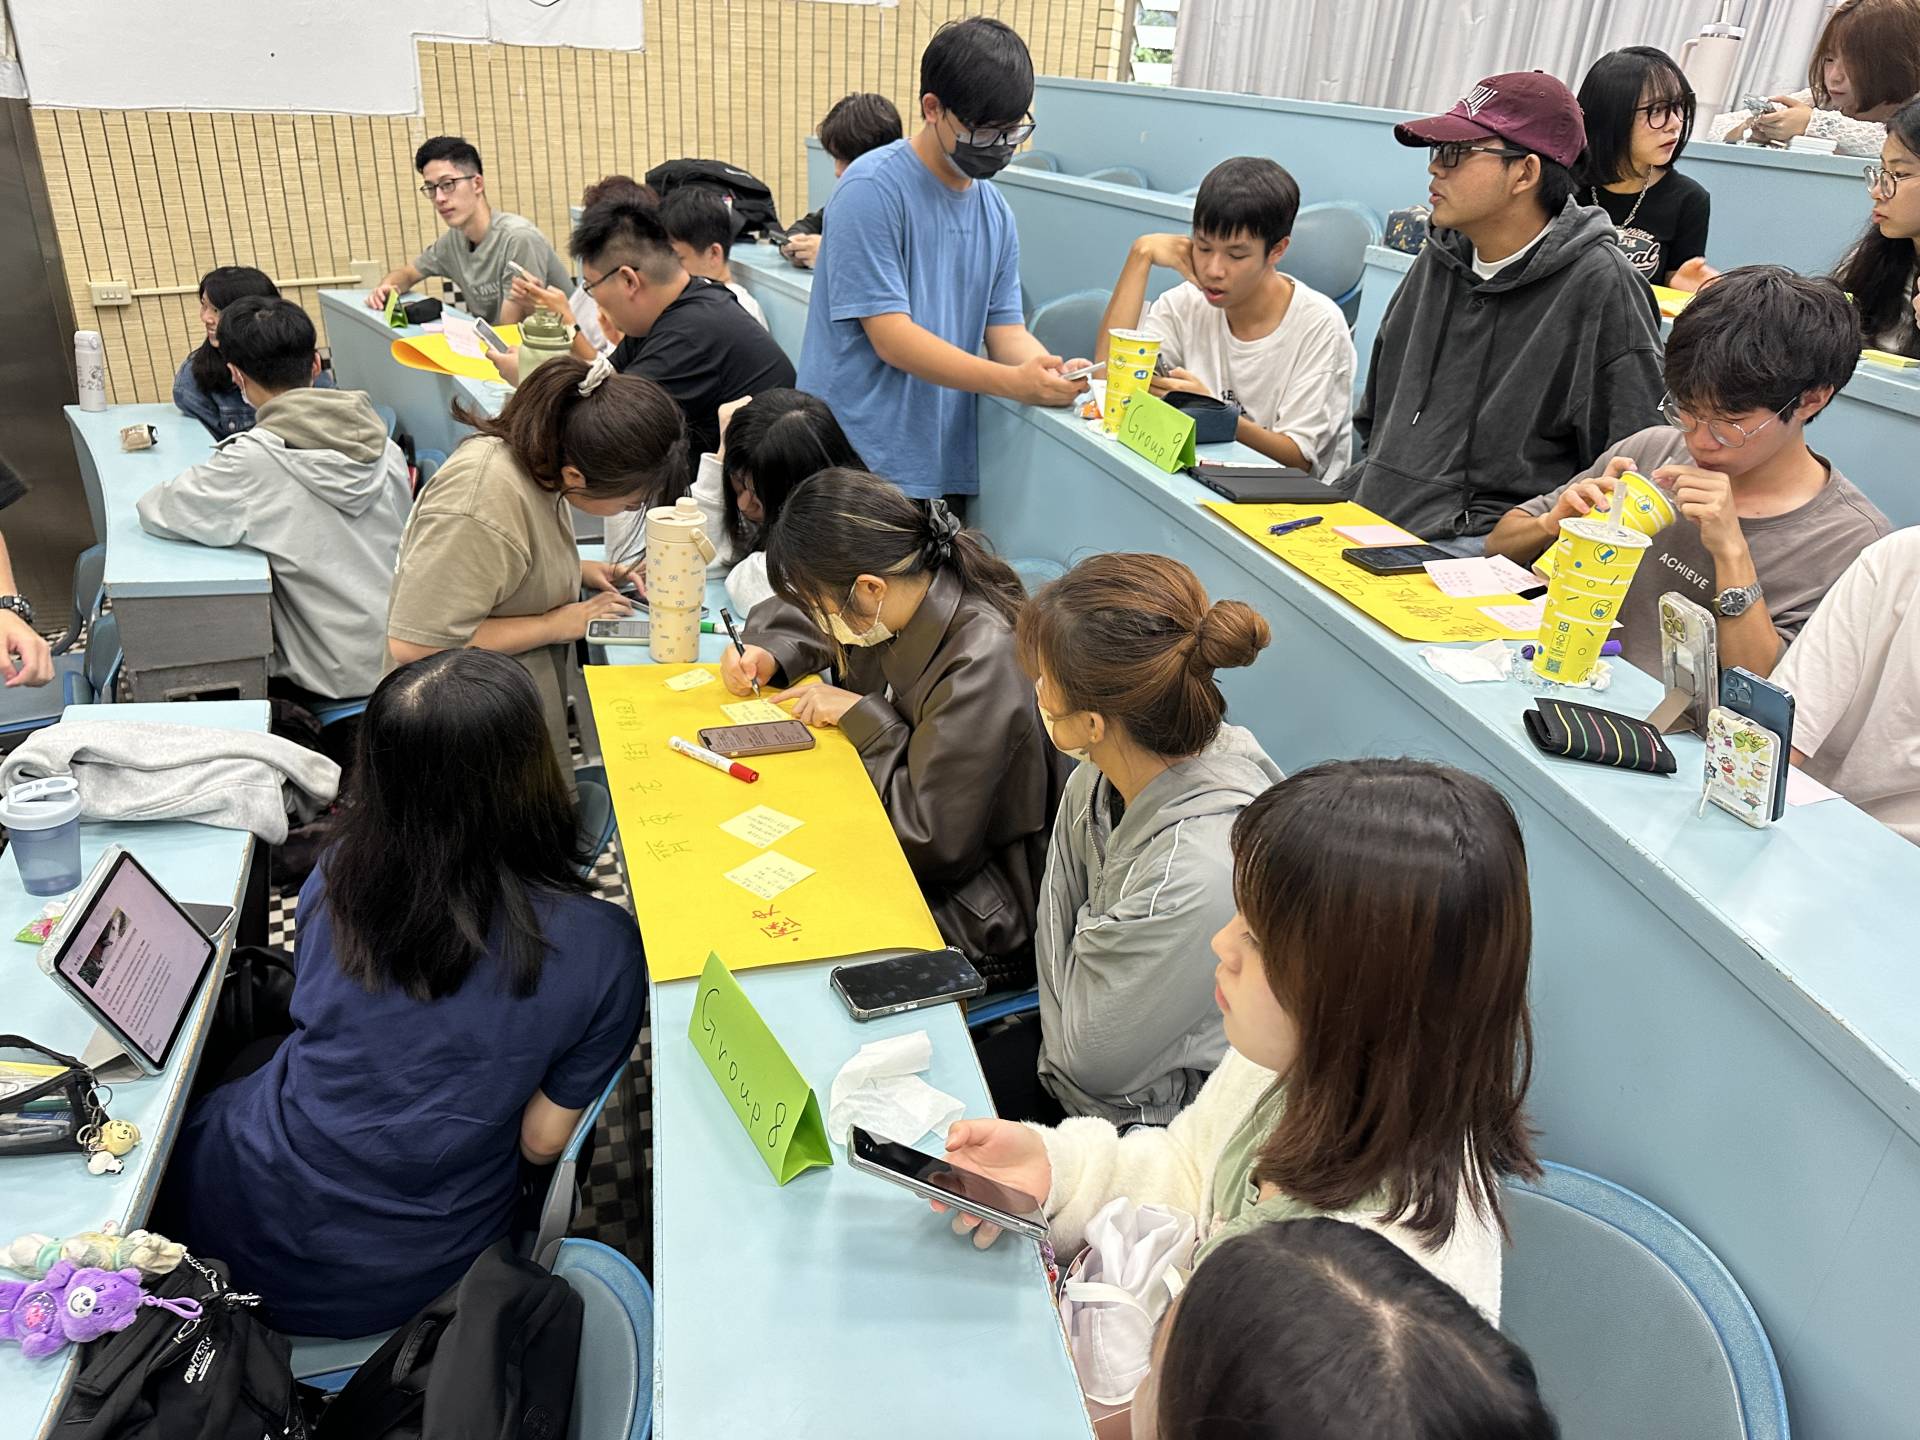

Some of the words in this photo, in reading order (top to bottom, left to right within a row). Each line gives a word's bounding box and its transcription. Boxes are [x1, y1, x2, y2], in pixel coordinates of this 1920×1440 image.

[1127, 404, 1165, 464] Group
[1169, 432, 1183, 462] 9
[1658, 551, 1709, 590] ACHIEVE
[702, 988, 761, 1129] Group
[767, 1102, 787, 1148] 8
